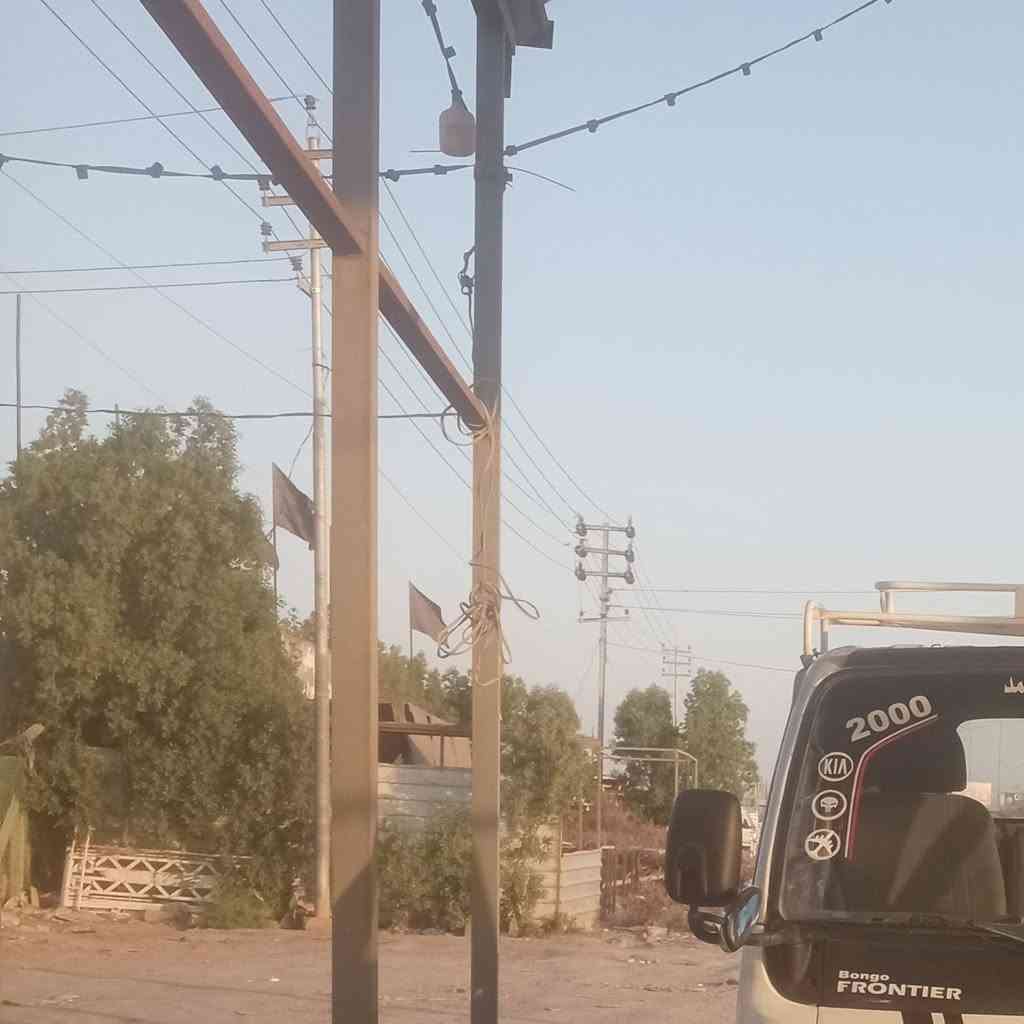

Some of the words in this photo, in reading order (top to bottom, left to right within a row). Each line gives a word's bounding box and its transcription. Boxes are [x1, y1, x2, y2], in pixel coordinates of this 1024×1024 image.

[846, 695, 933, 742] 2000
[822, 755, 849, 777] KIA
[839, 970, 890, 982] Bongo
[837, 981, 962, 1000] FRONTIER
